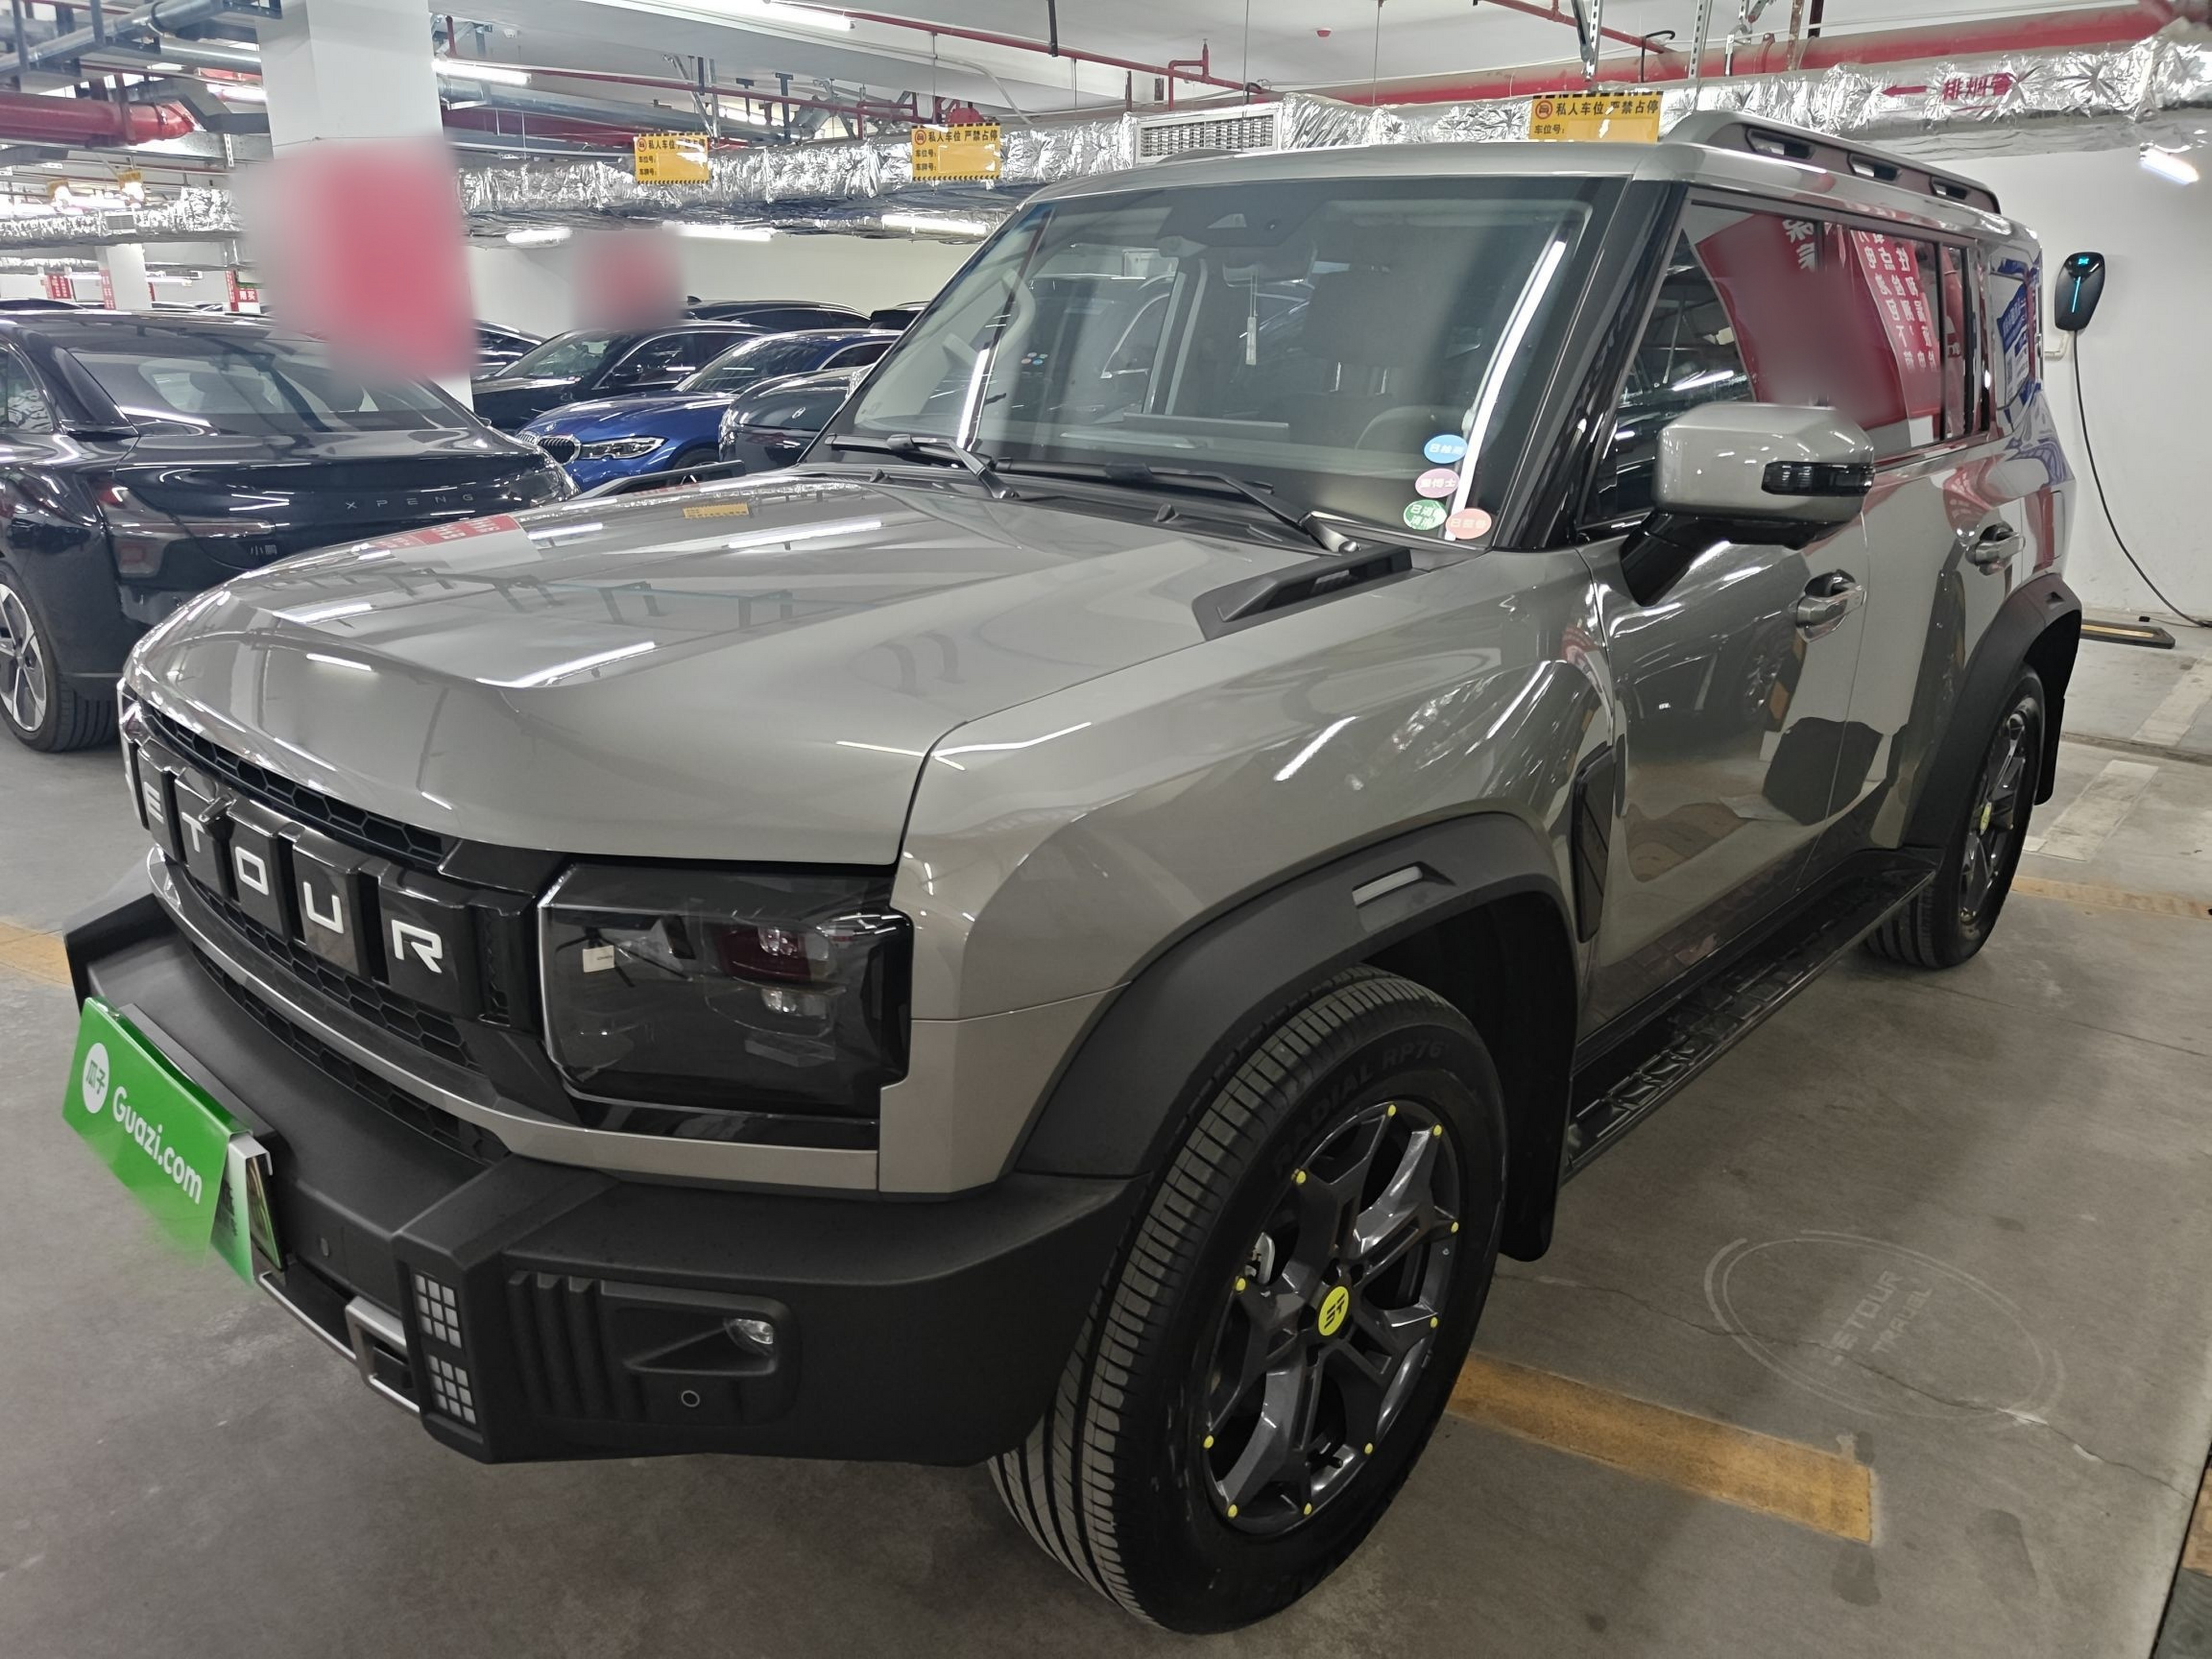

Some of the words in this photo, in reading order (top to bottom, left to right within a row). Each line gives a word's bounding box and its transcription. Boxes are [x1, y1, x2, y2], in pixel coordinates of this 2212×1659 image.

[1555, 101, 1604, 116] 私人车位
[1609, 99, 1659, 115] 严禁占停
[928, 131, 961, 142] 私人车位
[964, 129, 998, 142] 严禁占停
[648, 139, 676, 150] 私人车位
[344, 493, 474, 511] XPENG
[86, 1059, 106, 1094] 瓜子
[112, 1086, 203, 1205] Guazi.com
